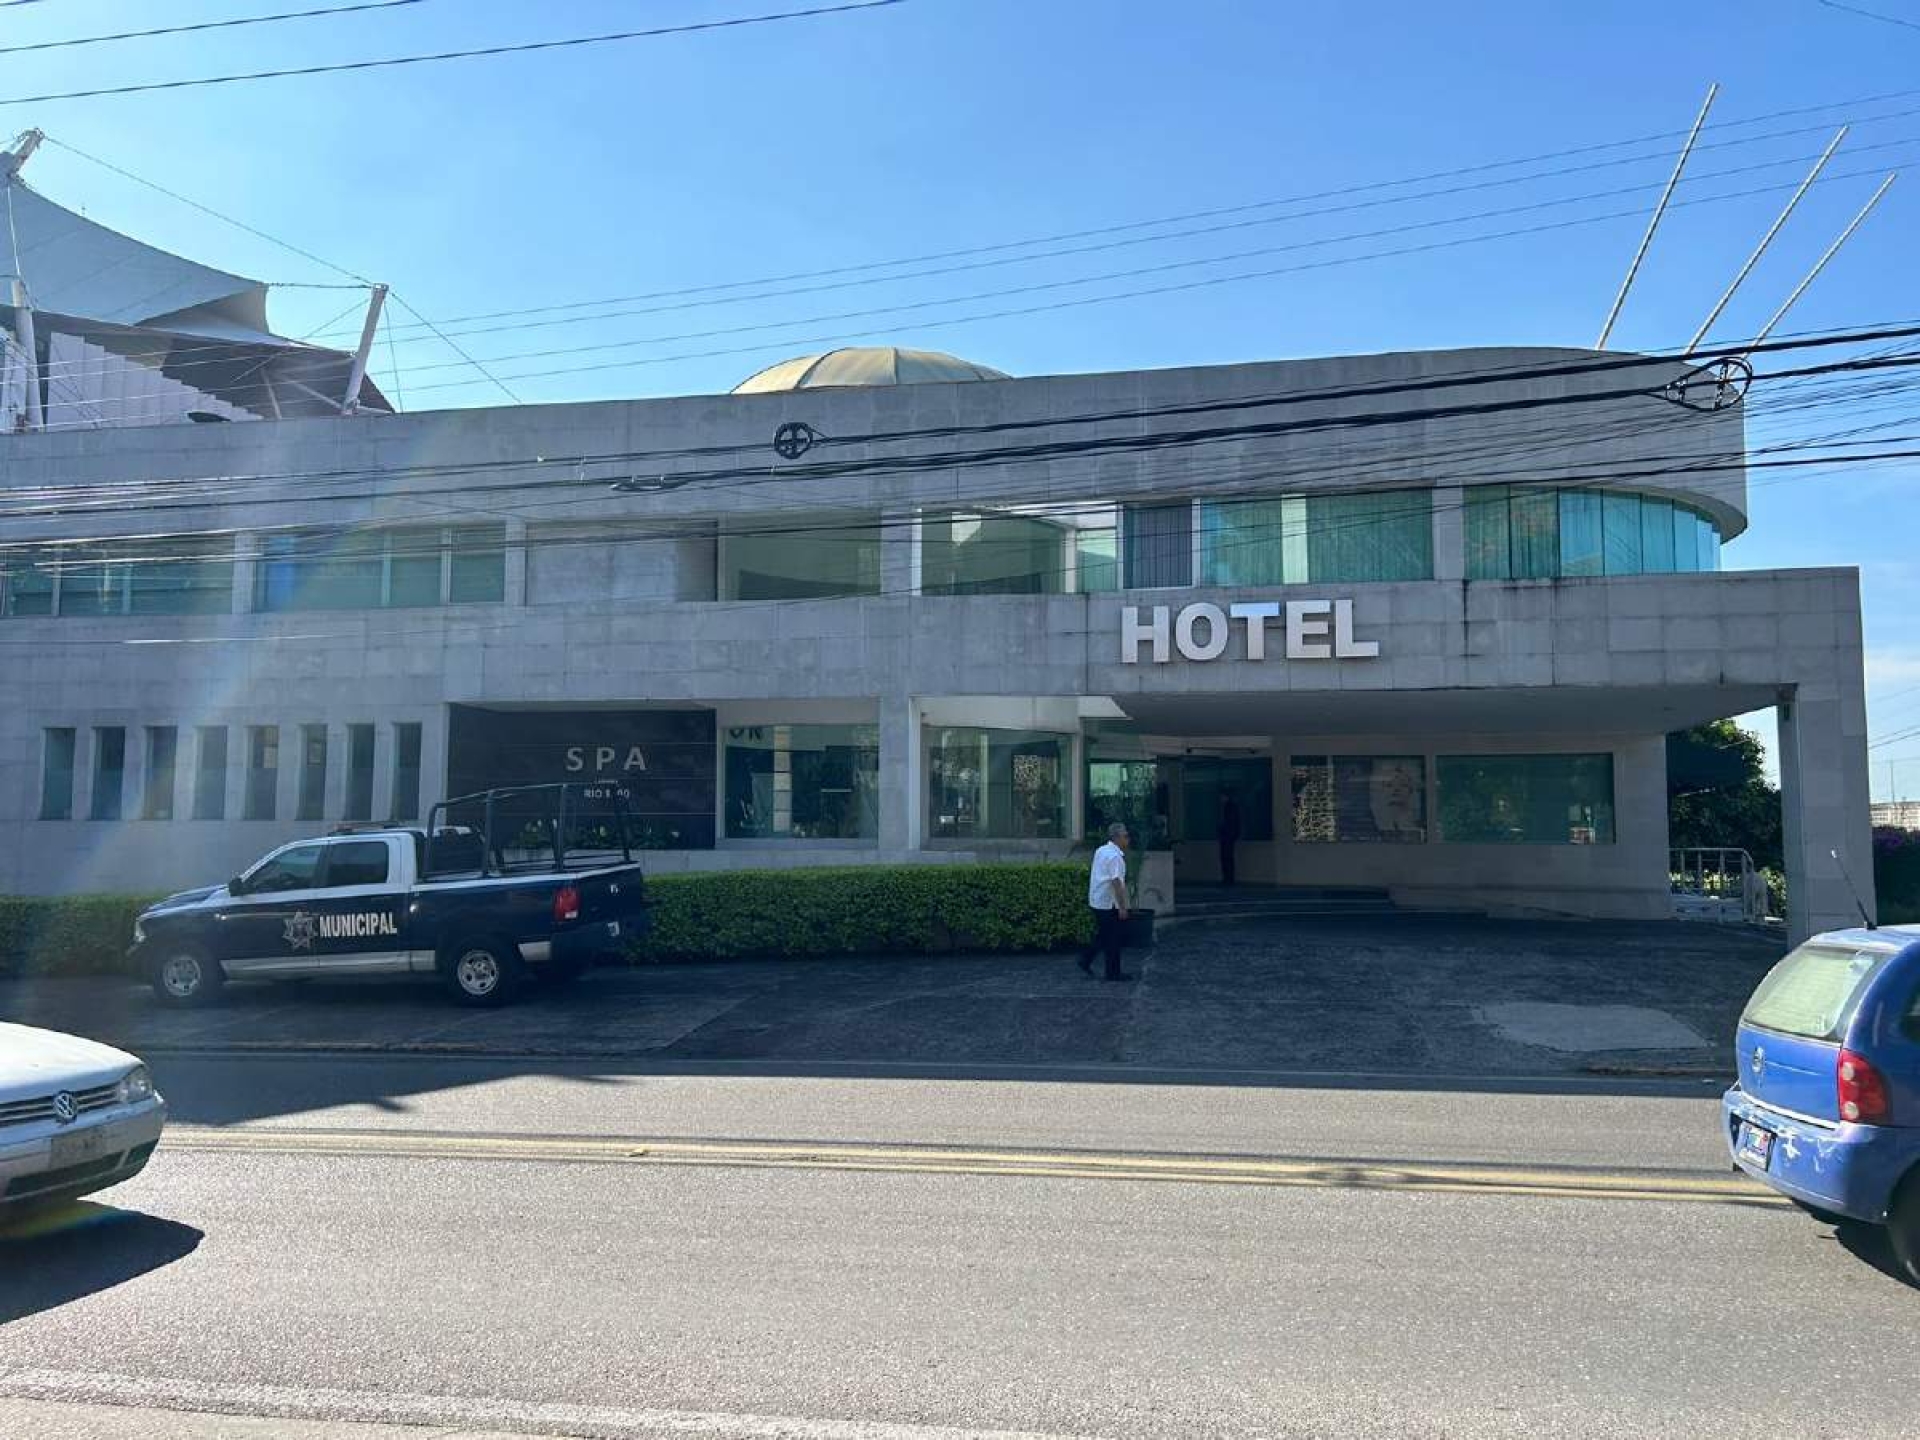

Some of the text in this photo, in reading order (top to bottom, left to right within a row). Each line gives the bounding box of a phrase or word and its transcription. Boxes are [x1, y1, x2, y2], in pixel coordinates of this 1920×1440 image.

[1121, 600, 1379, 663] HOTEL
[566, 746, 647, 771] SPA
[319, 912, 398, 938] MUNICIPAL
